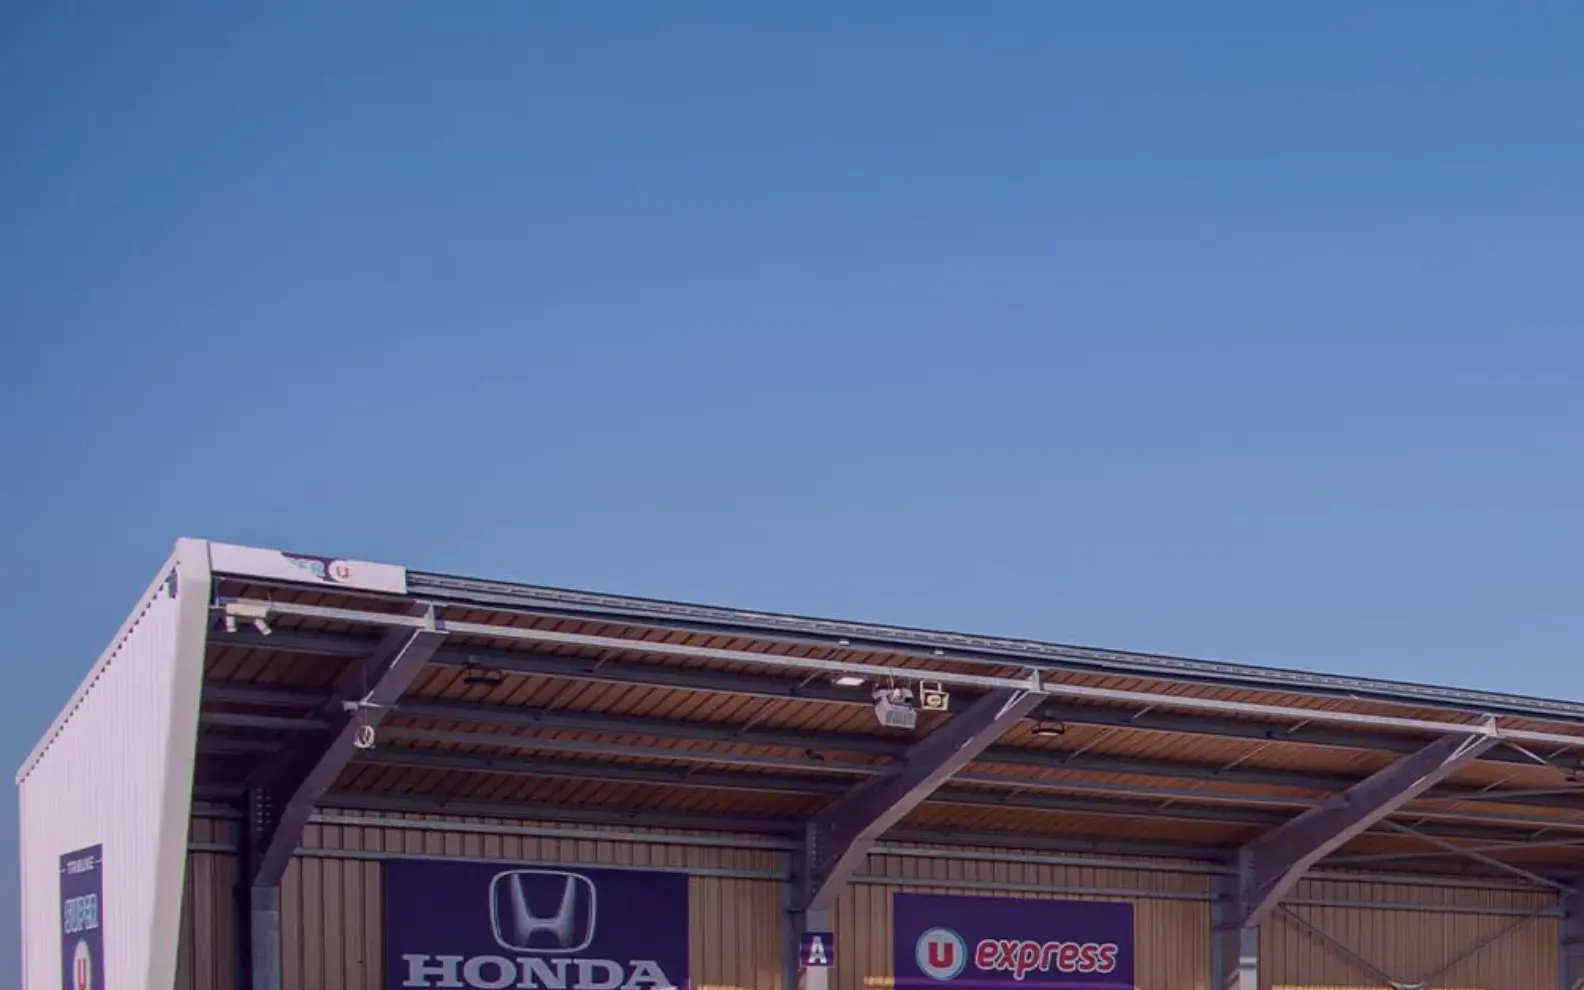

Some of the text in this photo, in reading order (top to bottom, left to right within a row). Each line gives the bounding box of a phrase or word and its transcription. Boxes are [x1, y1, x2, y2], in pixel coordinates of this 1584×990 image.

[64, 893, 99, 934] SUPER
[808, 935, 828, 964] A
[928, 938, 1117, 981] U express
